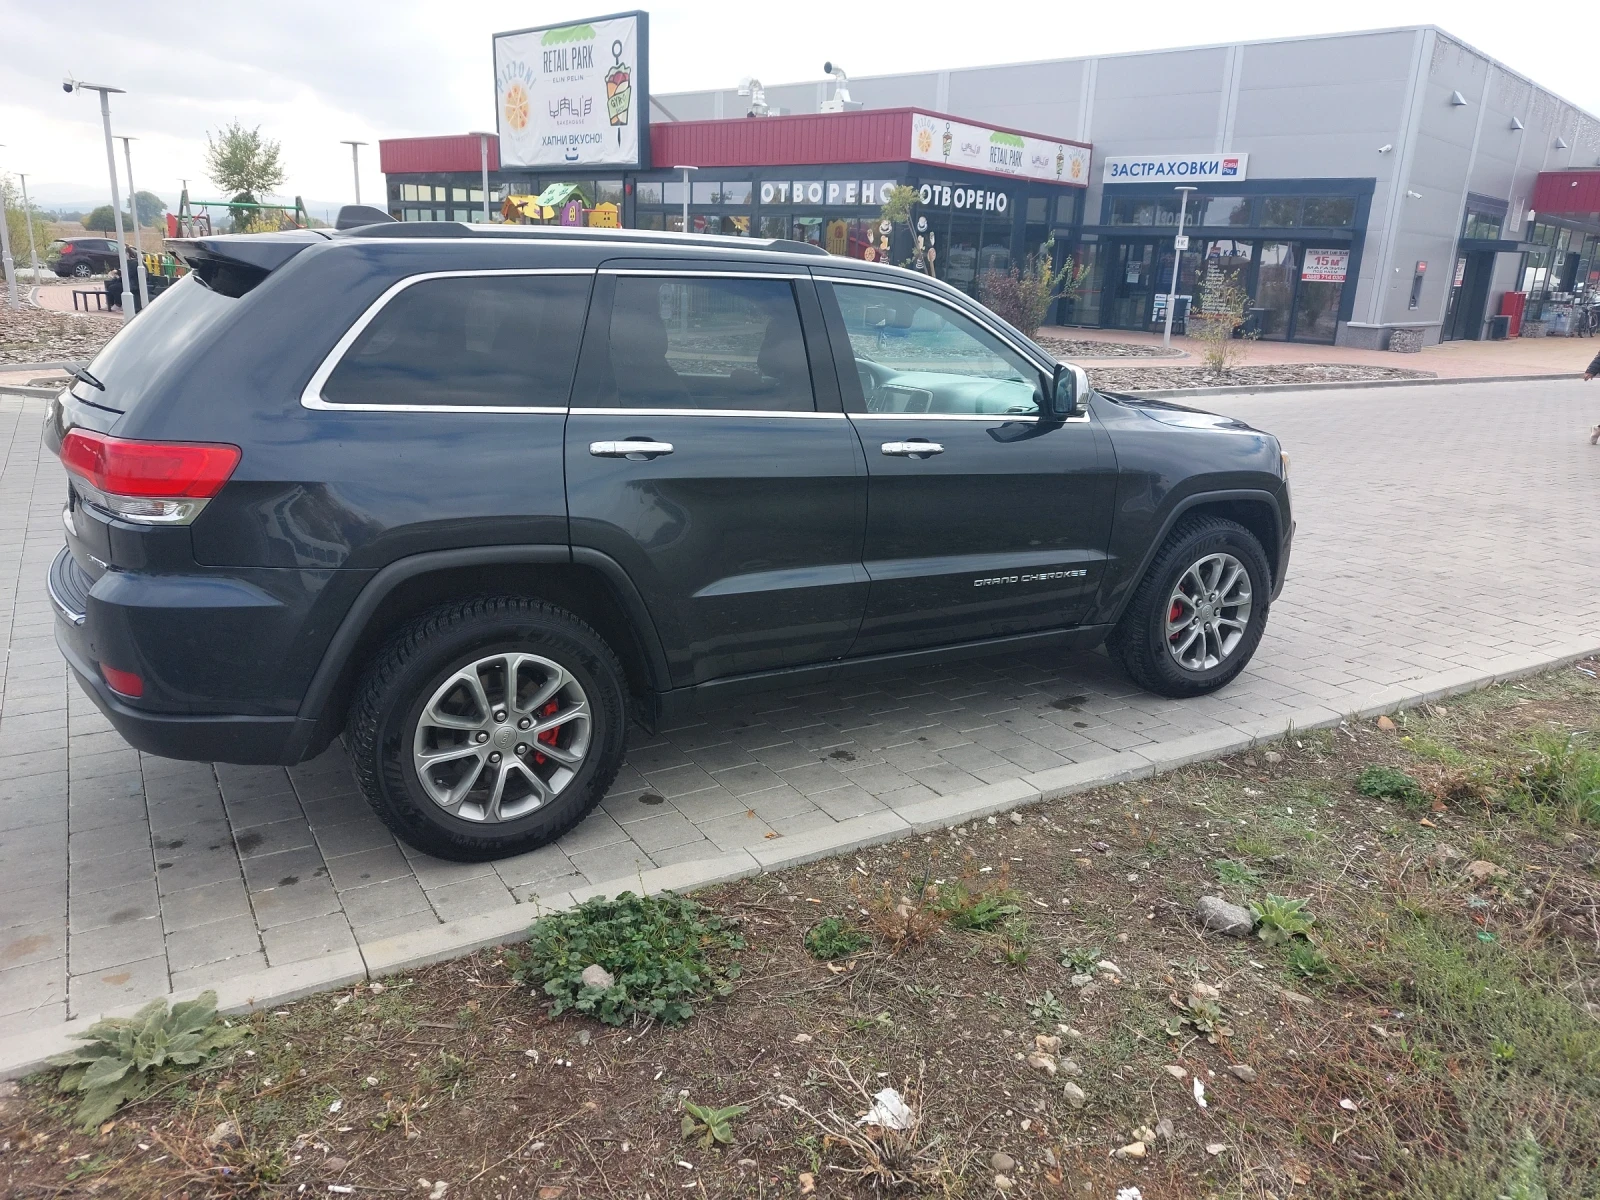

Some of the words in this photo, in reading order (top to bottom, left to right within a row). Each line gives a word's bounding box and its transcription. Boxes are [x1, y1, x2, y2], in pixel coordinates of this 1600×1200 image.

[543, 48, 569, 74] RETAIL
[571, 44, 594, 71] PARK
[497, 60, 537, 94] PIZZONI
[552, 76, 565, 84] ELIN
[566, 74, 584, 82] PELIN
[542, 135, 568, 147] ХАПНИ
[569, 132, 602, 145] ВКУСНО!
[989, 146, 1008, 166] RETAIL
[1008, 149, 1023, 168] PARK
[1111, 161, 1219, 177] ЗАСТРАХОВКИ
[1222, 167, 1235, 175] Pay
[761, 182, 898, 203] ОТВОРЕНО
[920, 184, 1007, 212] ОТВОРЕНО
[1315, 256, 1330, 266] 15
[973, 575, 1019, 587] GRAND
[1020, 569, 1088, 582] CHEROKEE
